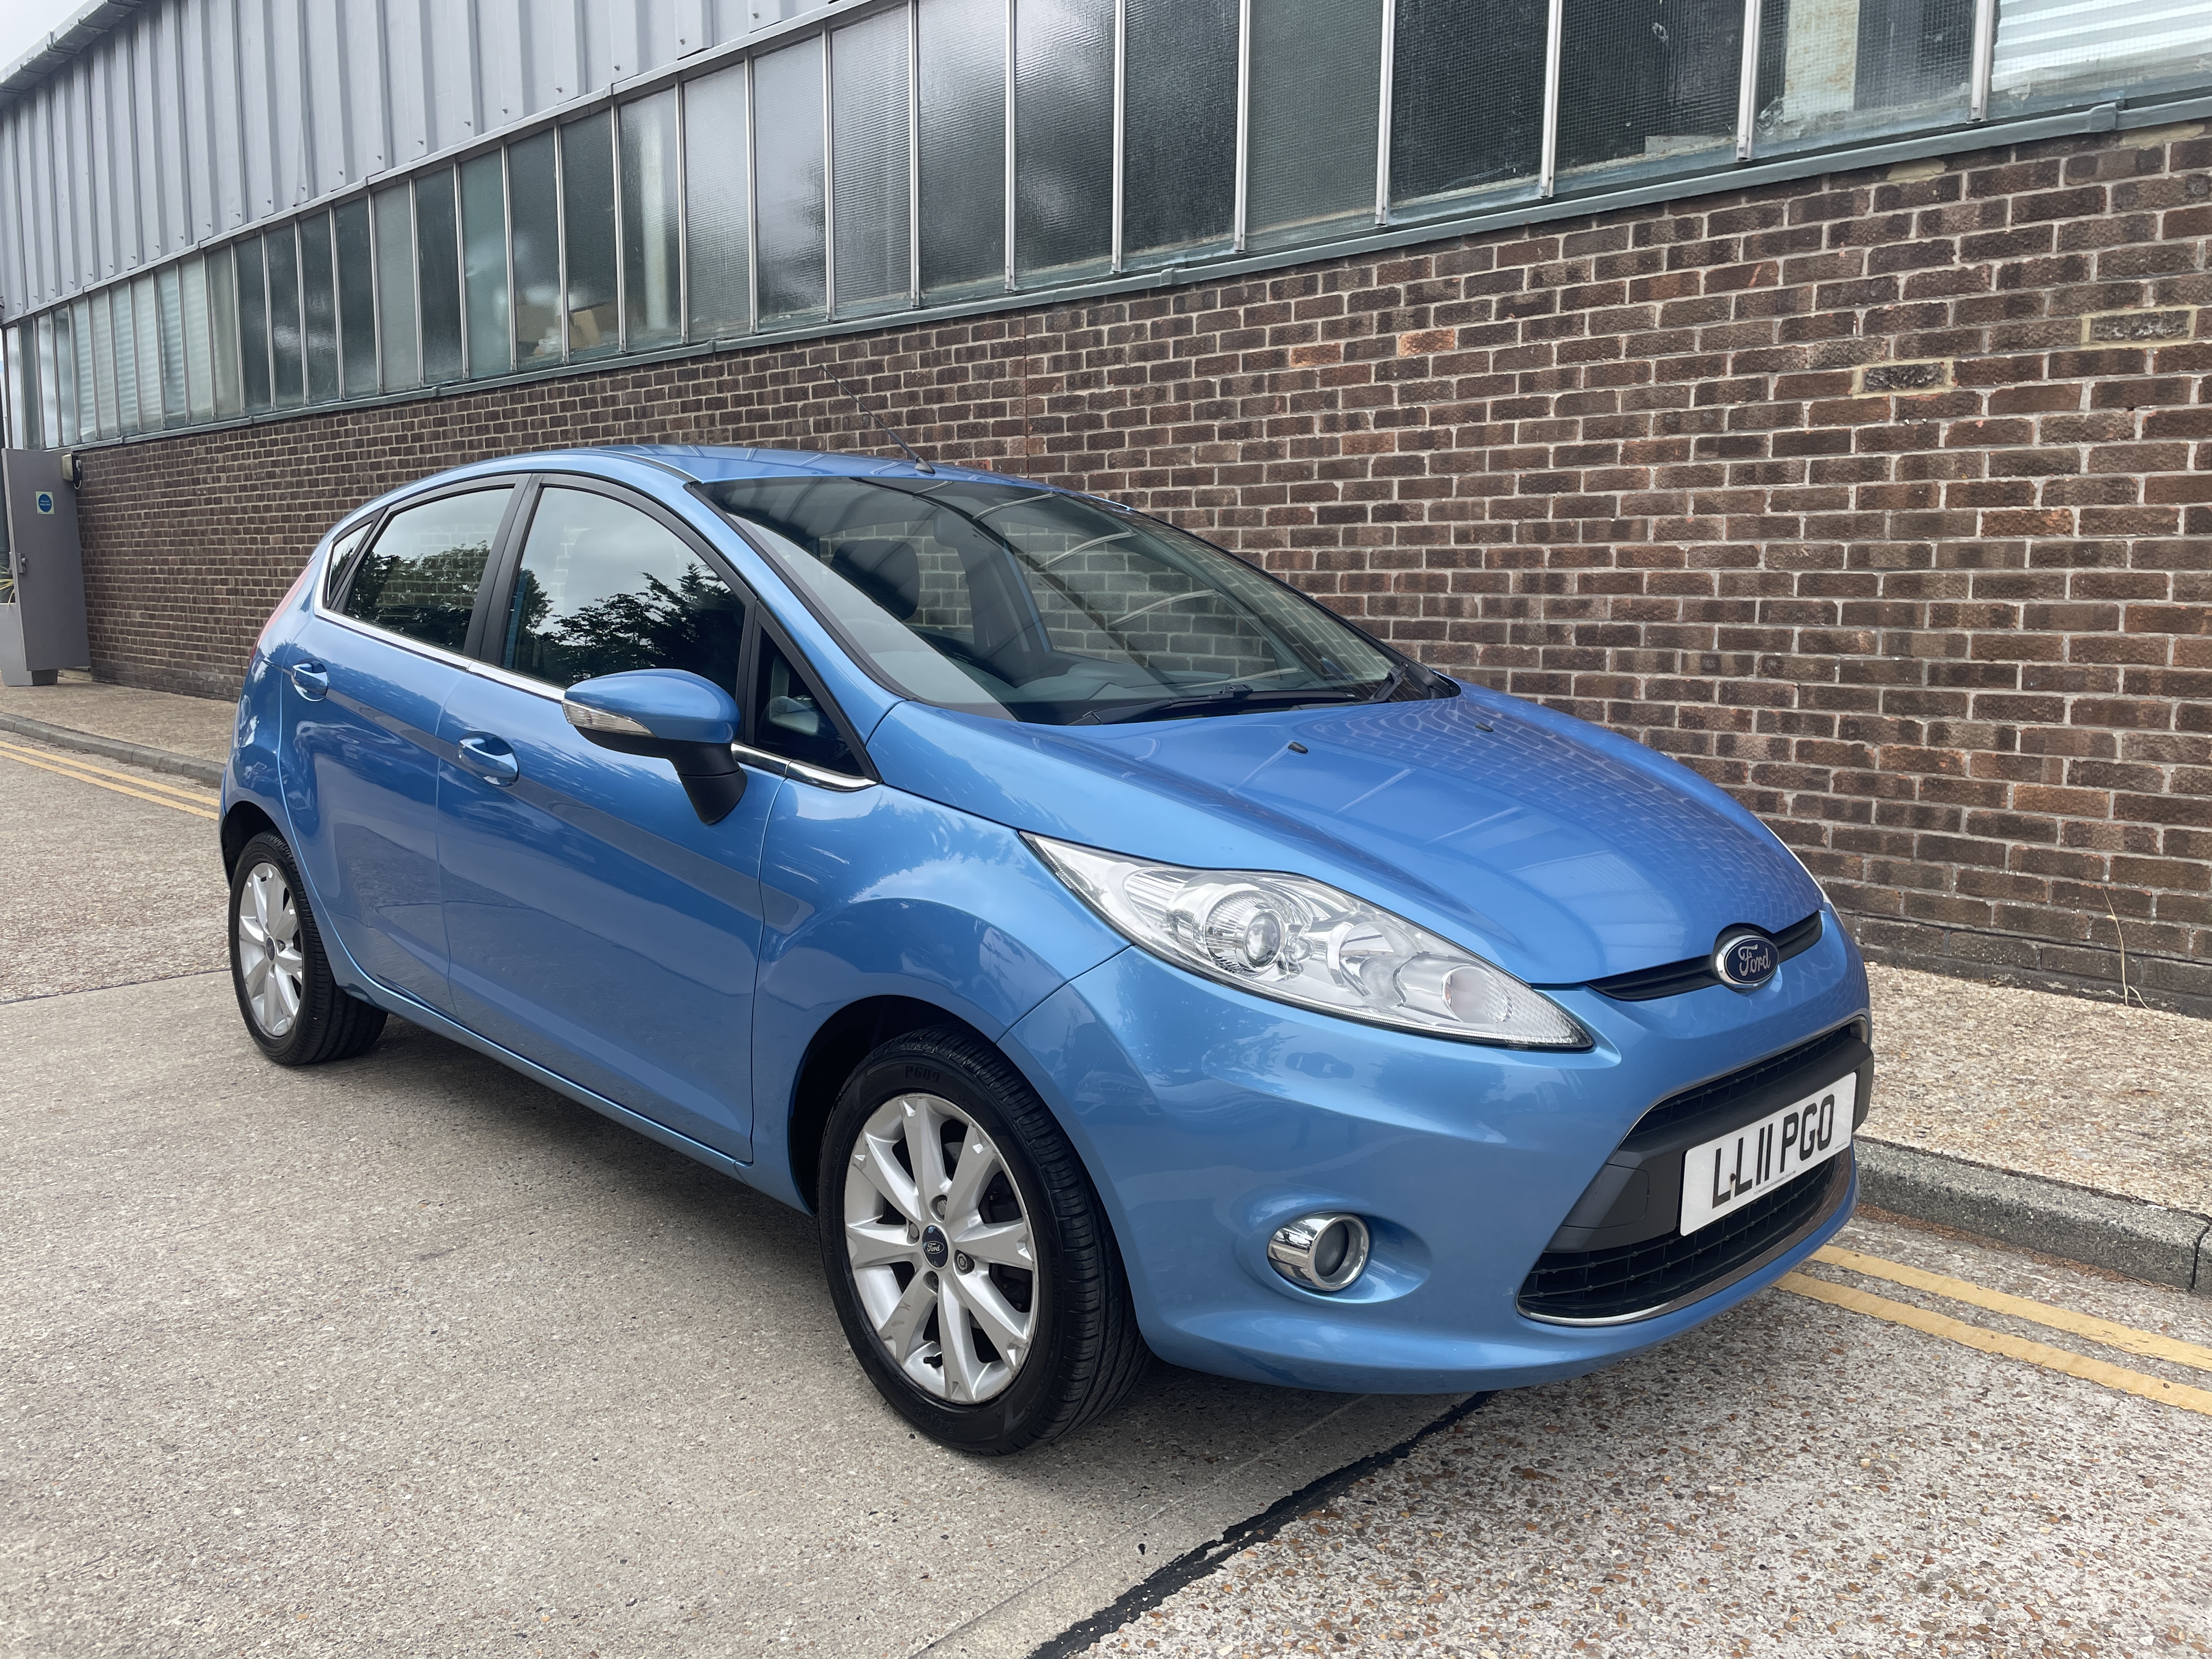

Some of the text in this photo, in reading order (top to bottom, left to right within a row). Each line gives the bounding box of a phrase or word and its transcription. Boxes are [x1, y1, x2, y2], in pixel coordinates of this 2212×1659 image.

[1738, 944, 1771, 976] Ford
[905, 1065, 940, 1083] P609
[1712, 1094, 1835, 1209] LL11 PGO
[927, 1243, 941, 1252] Ford
